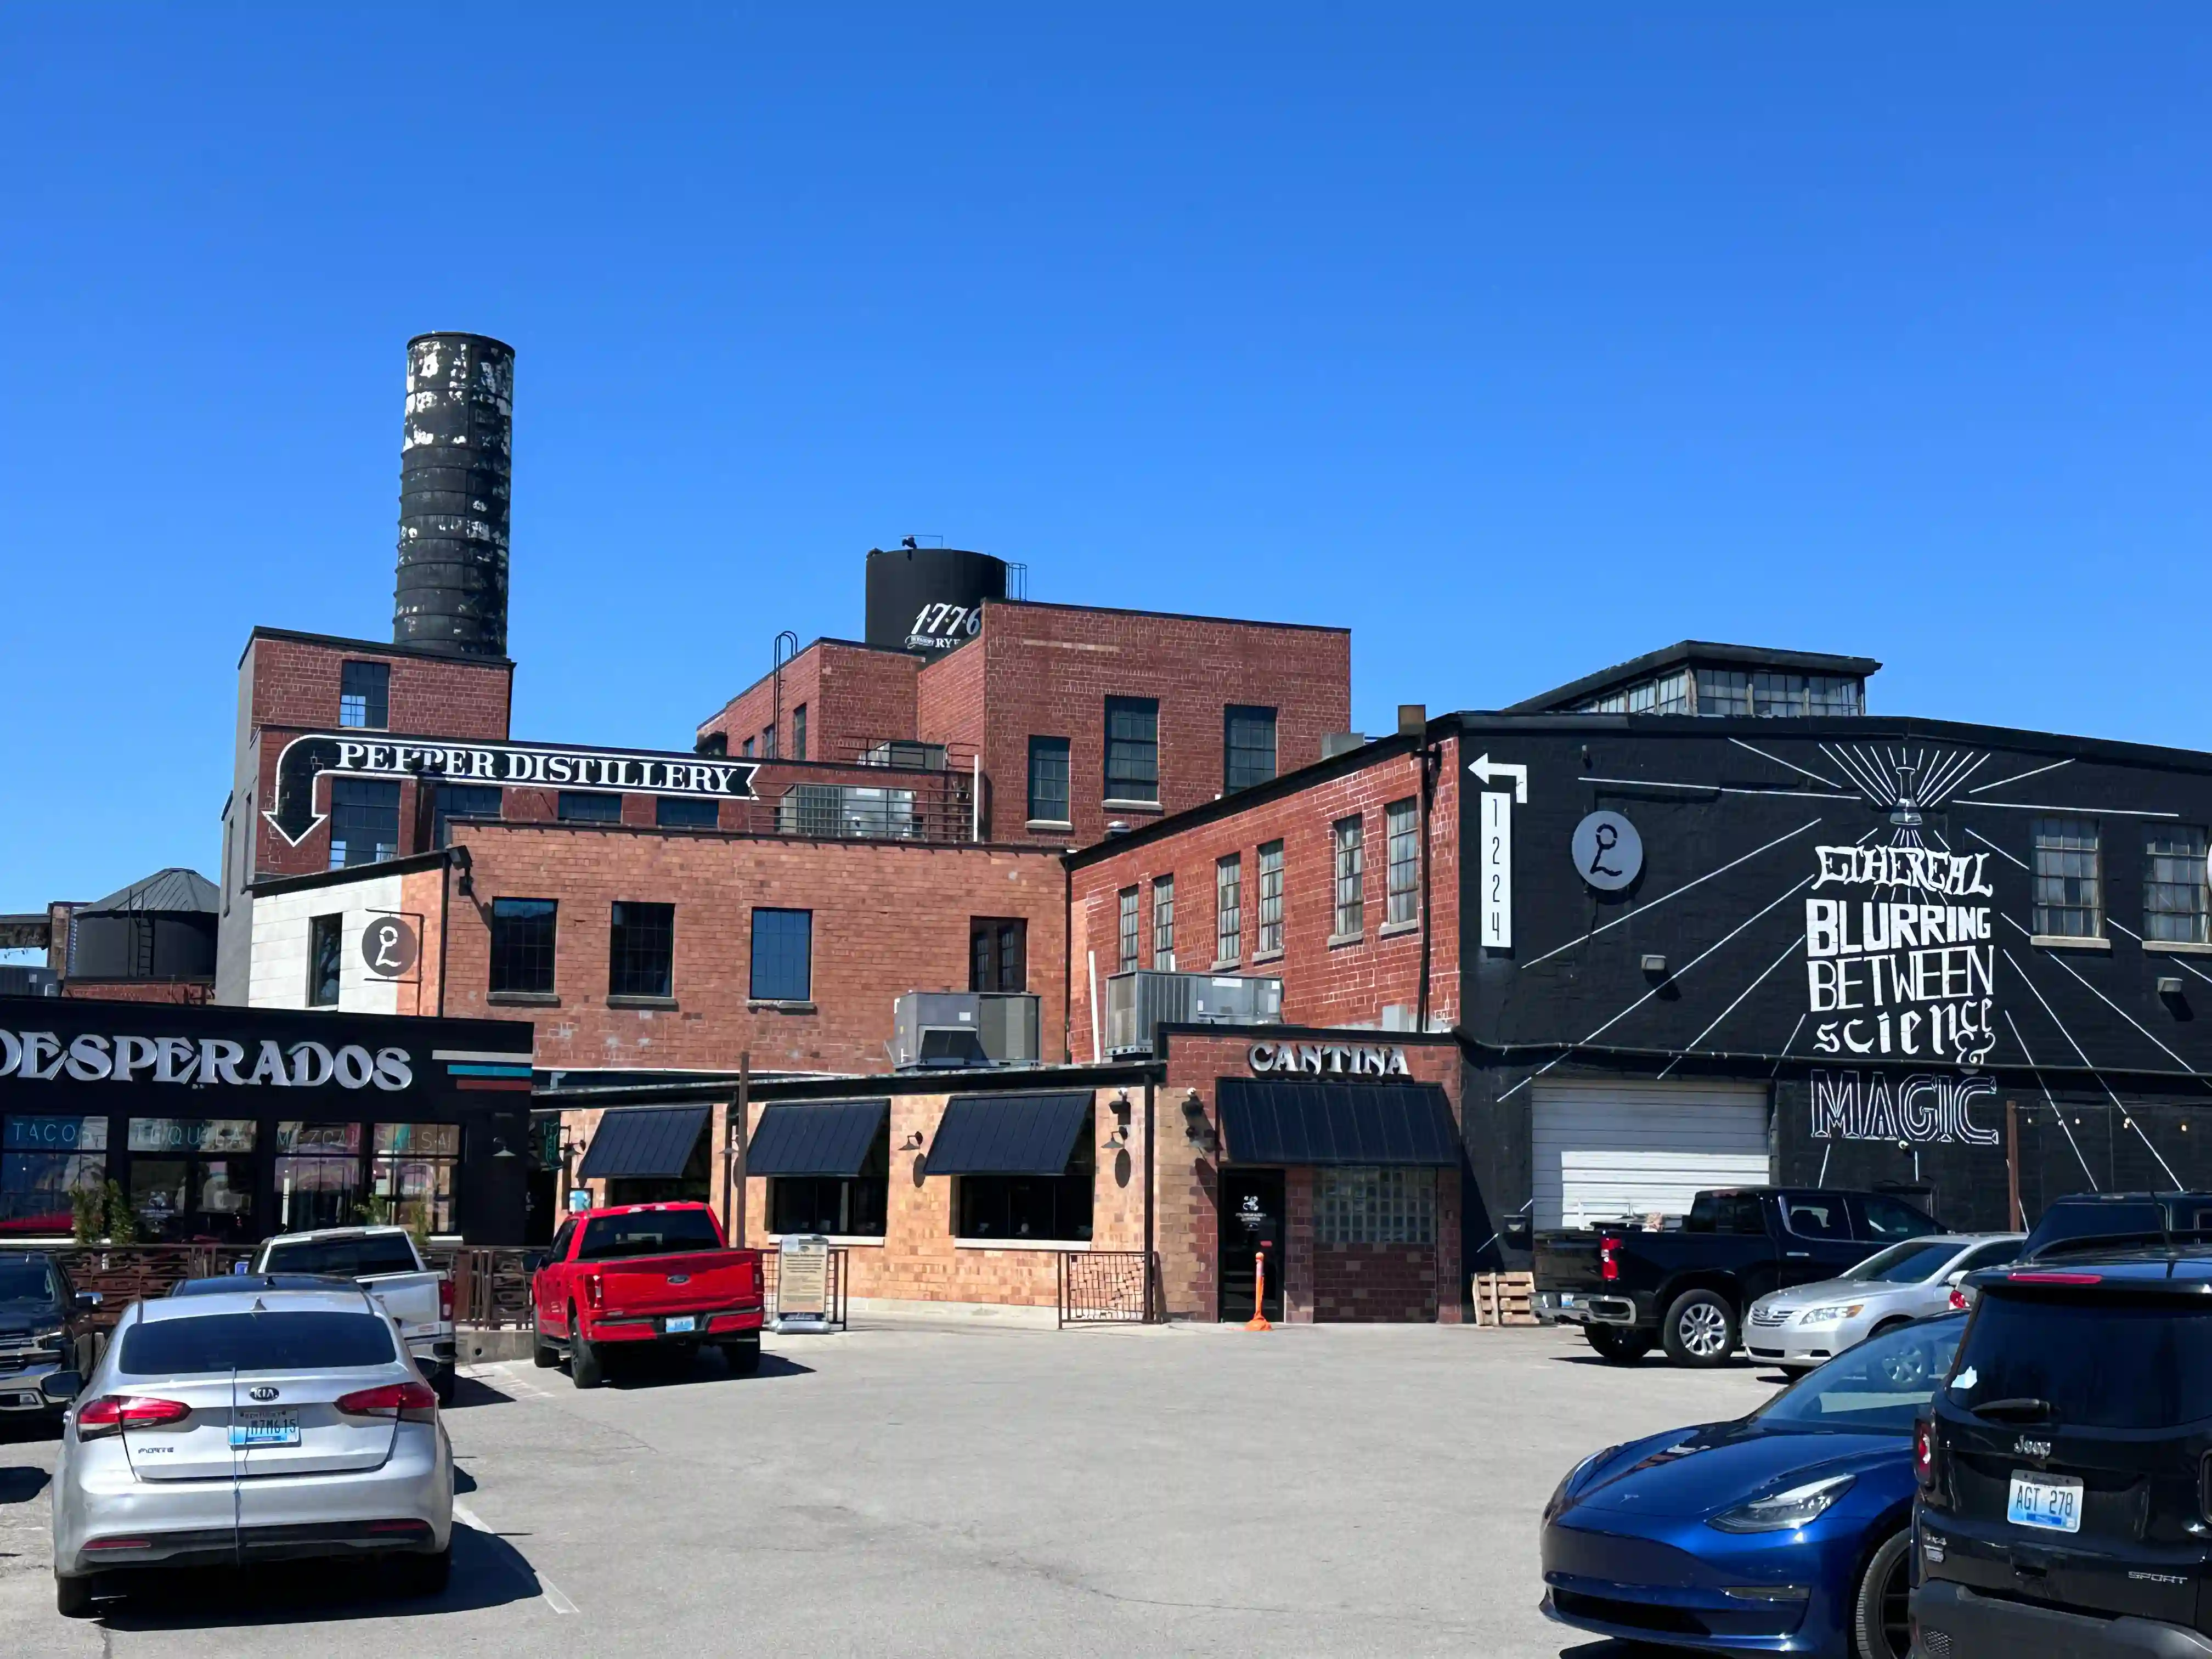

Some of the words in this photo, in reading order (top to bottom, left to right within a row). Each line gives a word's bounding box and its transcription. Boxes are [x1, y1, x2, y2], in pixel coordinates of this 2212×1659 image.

[911, 603, 981, 635] 1776
[335, 742, 496, 778] PEPPER
[504, 753, 737, 793] DISTILLERY
[1492, 798, 1500, 941] 1224
[1812, 845, 1993, 898] ETHEREAL
[1806, 898, 1991, 957] BLURRING
[1807, 945, 1995, 1013] BETWEEN
[1250, 1043, 1409, 1075] CANTINA
[1811, 1069, 1999, 1145] MAGIC
[135, 1124, 245, 1147] TEQULA
[2014, 1435, 2051, 1460] Jeep
[2016, 1485, 2040, 1511] AGT
[2049, 1490, 2073, 1516] 278
[2128, 1571, 2188, 1584] SPORT
